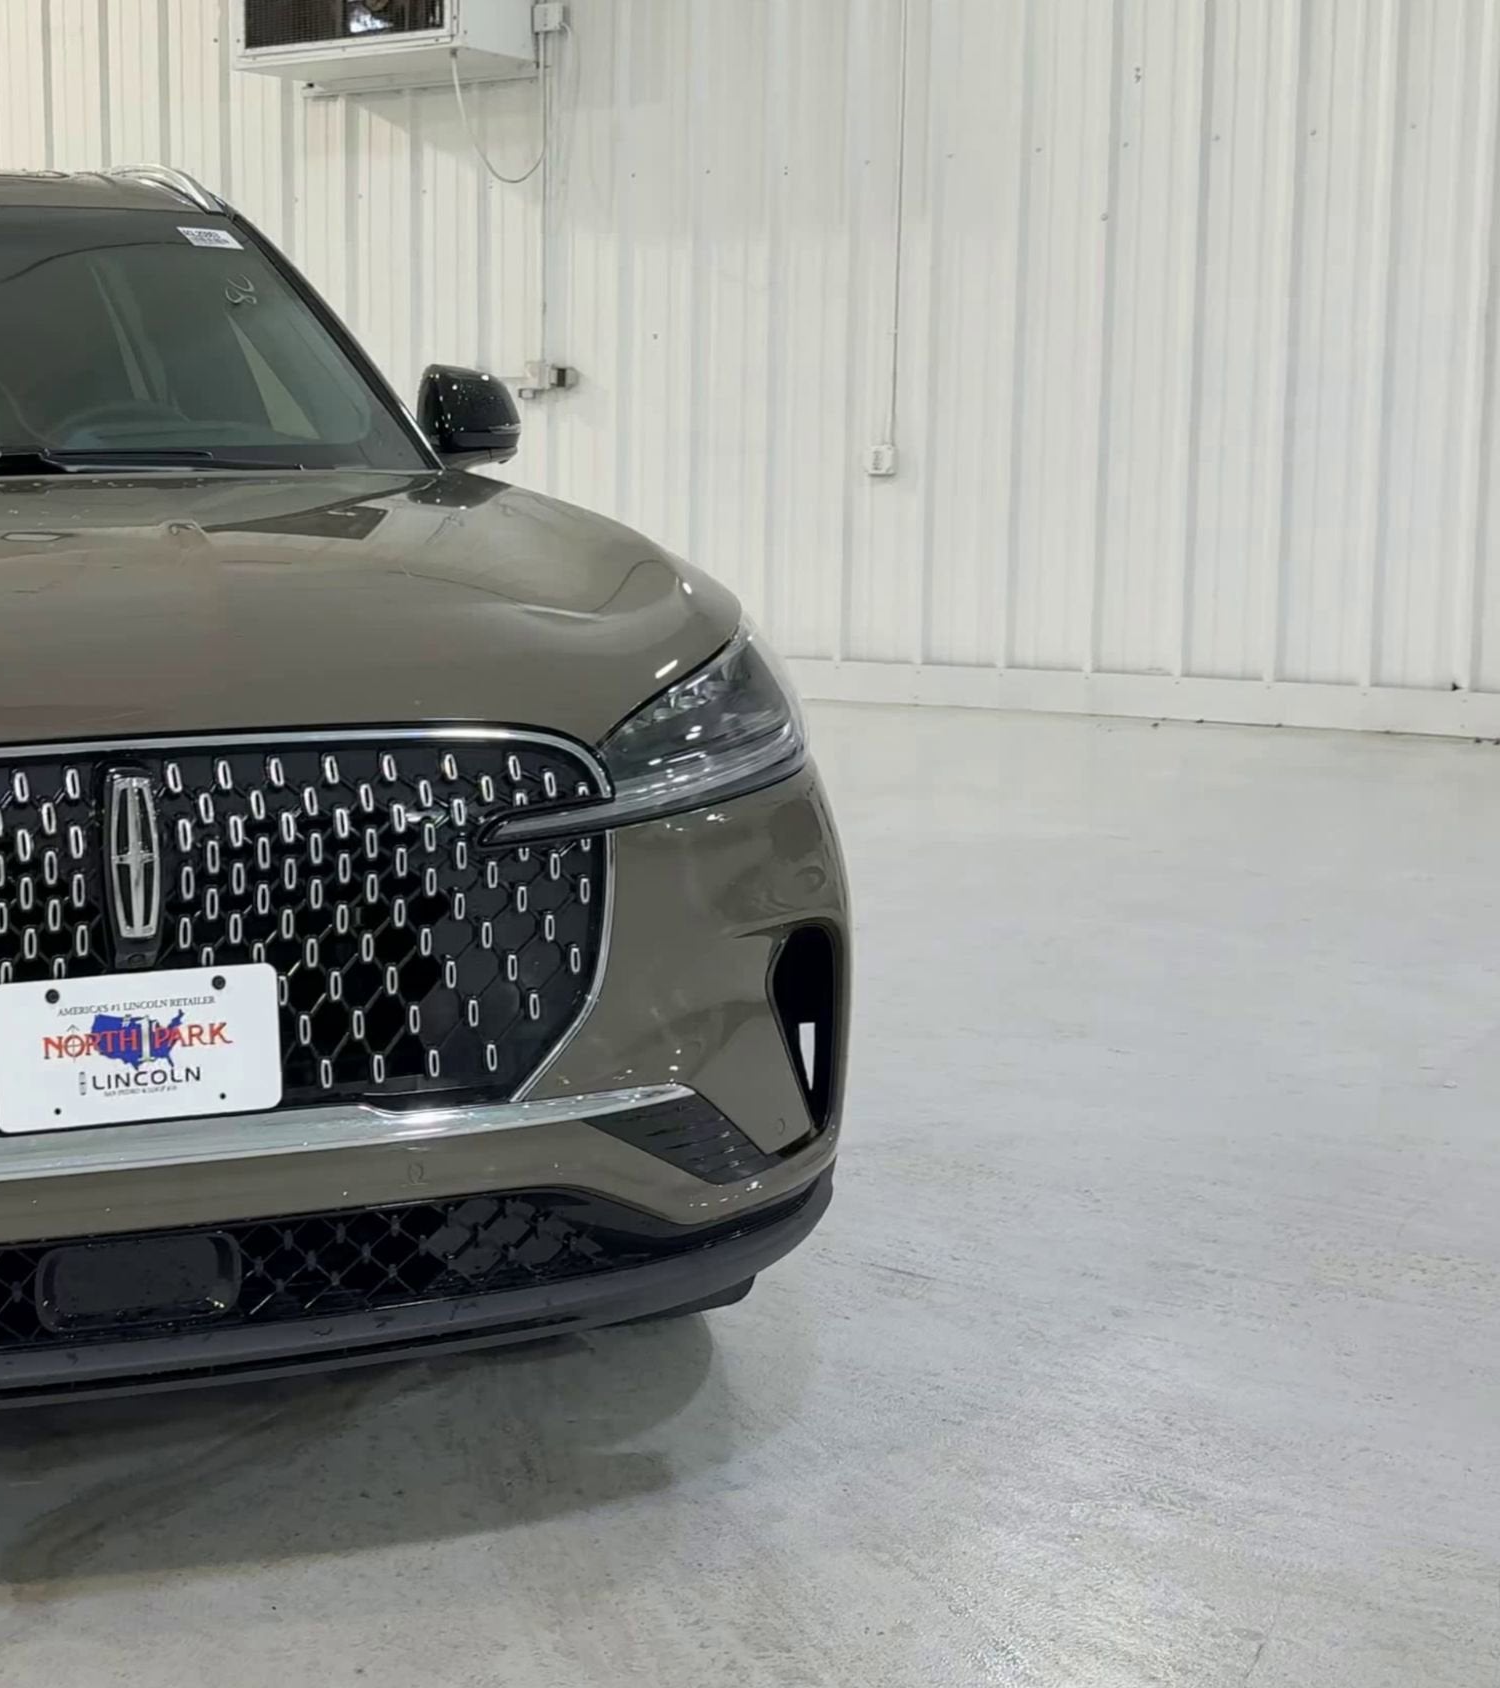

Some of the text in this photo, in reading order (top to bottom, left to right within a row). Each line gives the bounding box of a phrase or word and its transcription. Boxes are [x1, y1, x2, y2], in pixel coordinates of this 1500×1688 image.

[58, 996, 216, 1016] AMERICA'S #1 LINCOLN RETAILER
[43, 1022, 233, 1059] NORTH PARK
[92, 1066, 200, 1090] LINCOLN
